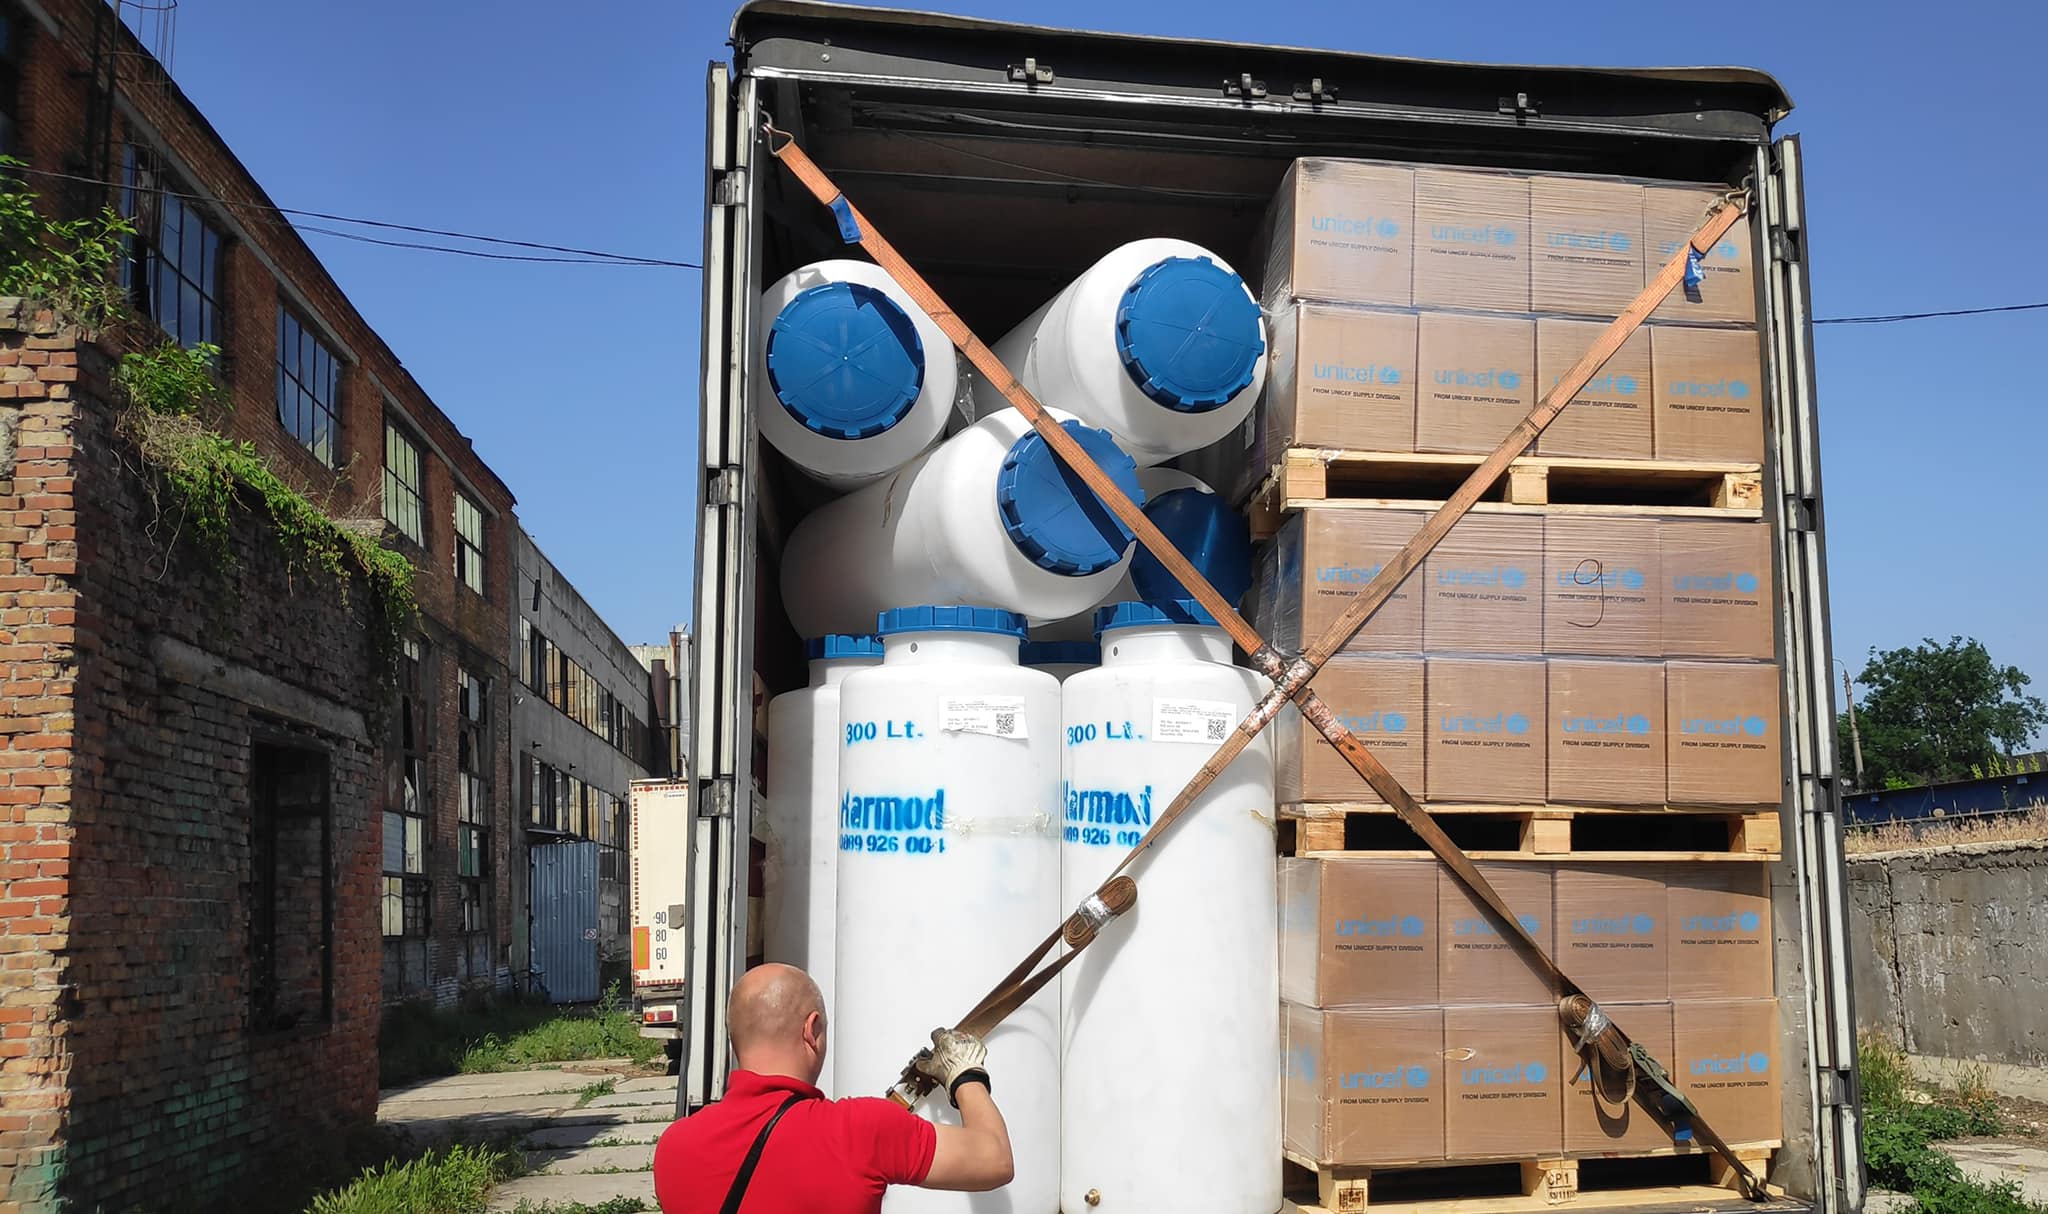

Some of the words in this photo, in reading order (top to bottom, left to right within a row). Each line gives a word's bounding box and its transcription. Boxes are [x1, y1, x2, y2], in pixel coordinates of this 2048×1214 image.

[1311, 214, 1373, 237] unicef
[1431, 223, 1491, 243] unicef
[1547, 230, 1606, 250] unicef
[1313, 361, 1375, 384] unicef
[1434, 367, 1494, 388] unicef
[1312, 387, 1330, 395] FROM
[1330, 389, 1352, 397] UNICEF
[1352, 391, 1374, 399] SUPPLY
[1375, 393, 1401, 401] DIVISION
[1669, 377, 1726, 398] unicef
[1433, 392, 1450, 400] FROM
[1451, 394, 1472, 402] UNICEF
[1495, 397, 1520, 405] DIVISION
[1438, 565, 1498, 587] unicef
[1672, 571, 1732, 592] unicef
[1335, 708, 1379, 732] icef
[1441, 709, 1503, 734] unicef
[1562, 712, 1623, 735] unicef
[1681, 713, 1741, 736] unicef
[846, 721, 877, 745] 300
[887, 720, 923, 738] Lt.
[1067, 723, 1096, 745] 300
[1505, 741, 1530, 749] DIVISION
[866, 834, 899, 852] 926
[1082, 828, 1111, 845] 926
[655, 911, 667, 924] 90
[1335, 913, 1397, 937] unicef
[1572, 911, 1629, 935] unicef
[1680, 911, 1737, 932] unicef
[655, 929, 667, 942] 80
[655, 947, 667, 960] 60
[1461, 1062, 1520, 1085] unicef
[1690, 1053, 1745, 1075] unicef
[1340, 1065, 1403, 1089] unicef
[1746, 1080, 1768, 1088] DIVISION
[1480, 1092, 1500, 1100] UNICEF
